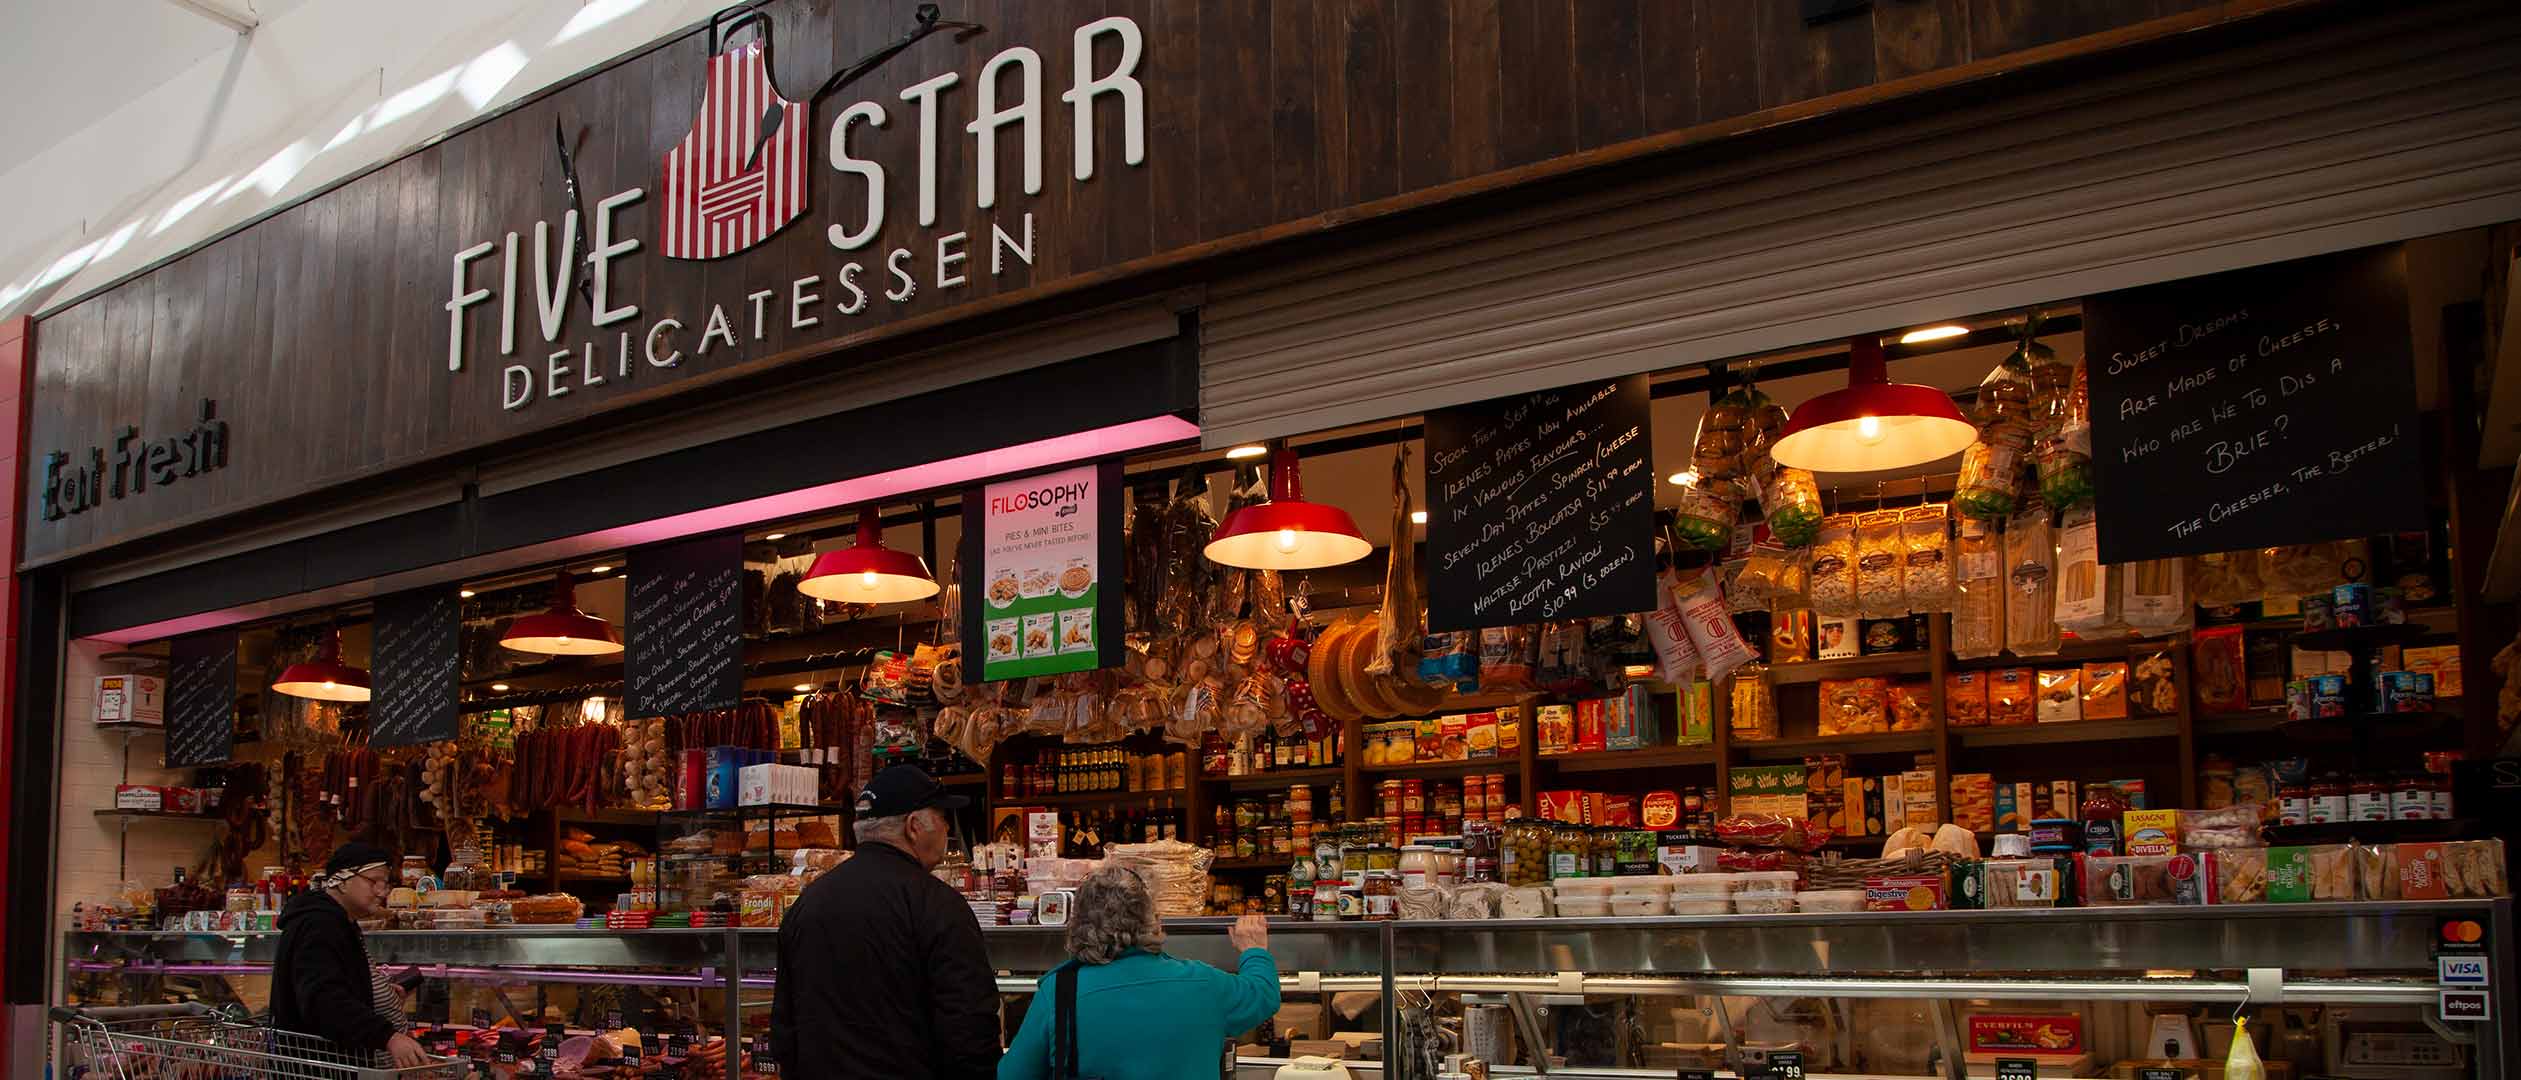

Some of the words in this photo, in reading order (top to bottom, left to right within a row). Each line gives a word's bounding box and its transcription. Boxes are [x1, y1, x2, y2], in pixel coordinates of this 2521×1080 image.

[445, 187, 645, 372] FIVE
[827, 16, 1145, 250] STAR
[503, 212, 1034, 410] DELICATESSEN
[40, 447, 106, 522] Eat
[109, 398, 229, 499] Fresh
[991, 481, 1089, 516] FILOSOPHY
[1005, 530, 1022, 542] PIES
[1033, 526, 1049, 538] MINI
[1052, 522, 1074, 533] BITES
[2135, 844, 2168, 853] DIVELLA
[1868, 888, 1908, 900] Digestive
[2448, 963, 2481, 974] VISA
[2448, 1000, 2482, 1012] eftpos
